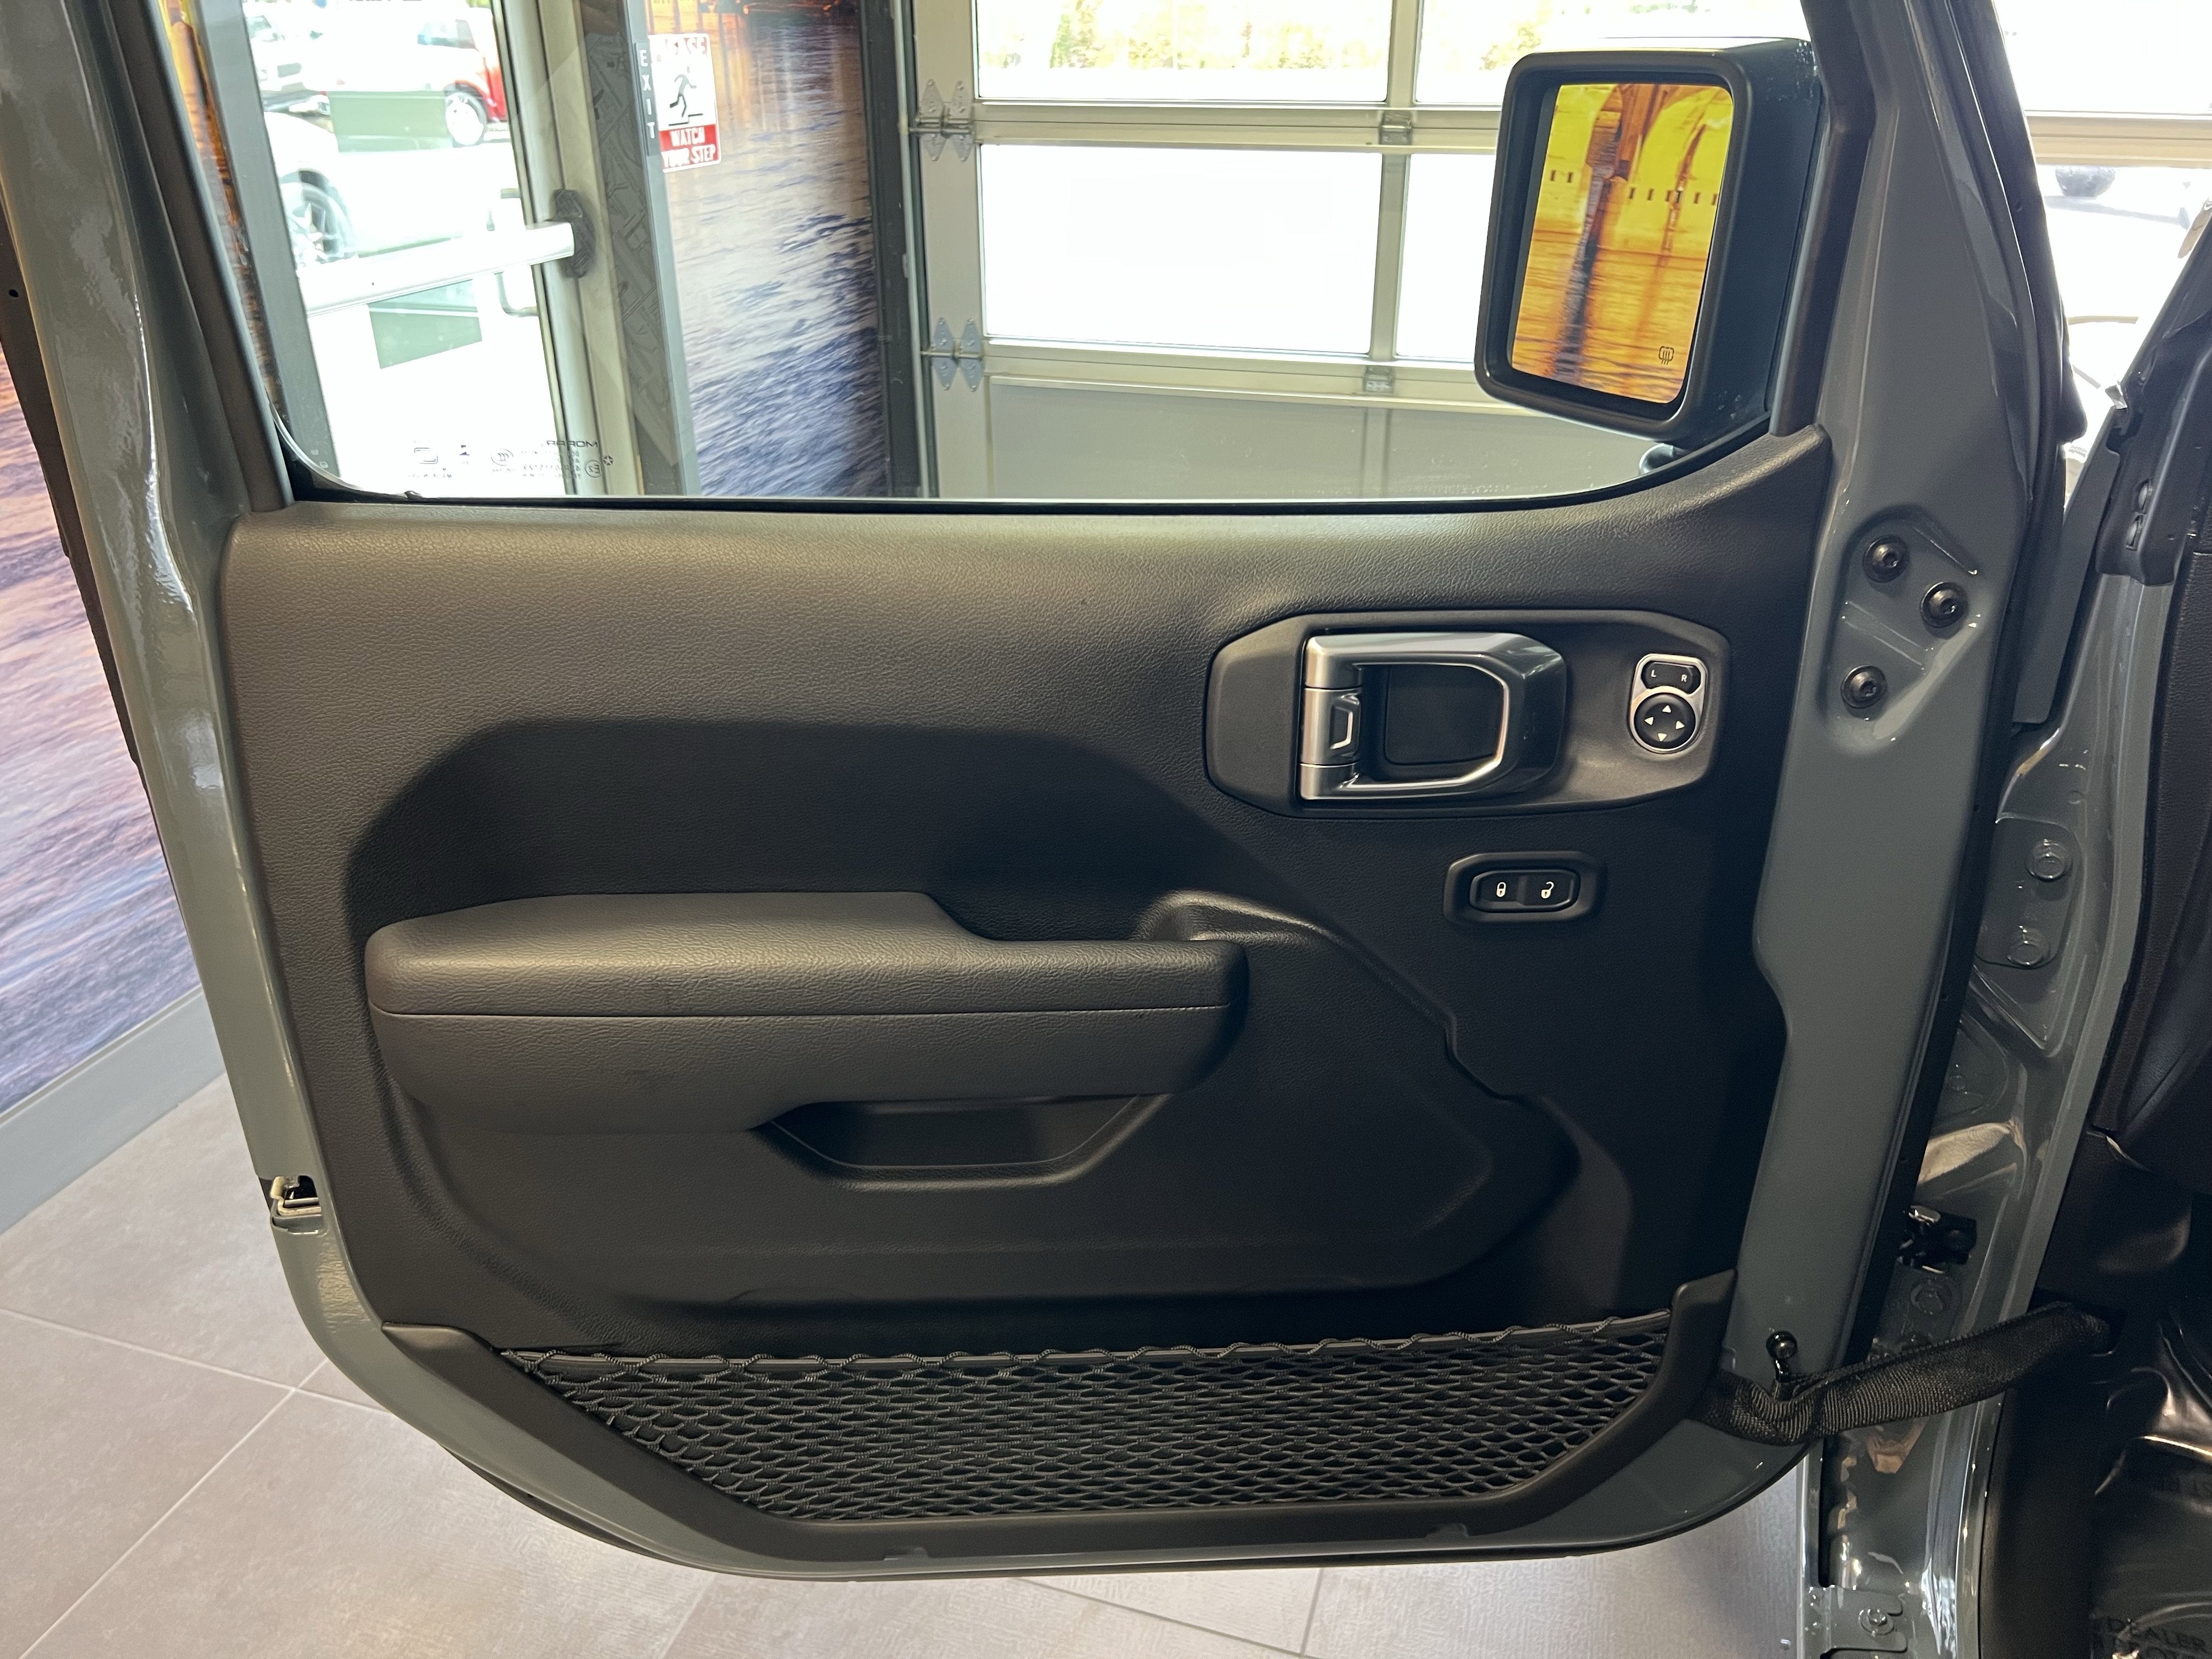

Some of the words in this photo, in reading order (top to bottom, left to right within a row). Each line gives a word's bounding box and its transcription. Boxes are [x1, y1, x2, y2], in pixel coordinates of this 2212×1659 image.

[640, 50, 655, 138] EXIT
[669, 127, 705, 147] WATCH
[661, 148, 690, 167] YOUR
[692, 144, 715, 163] STEP
